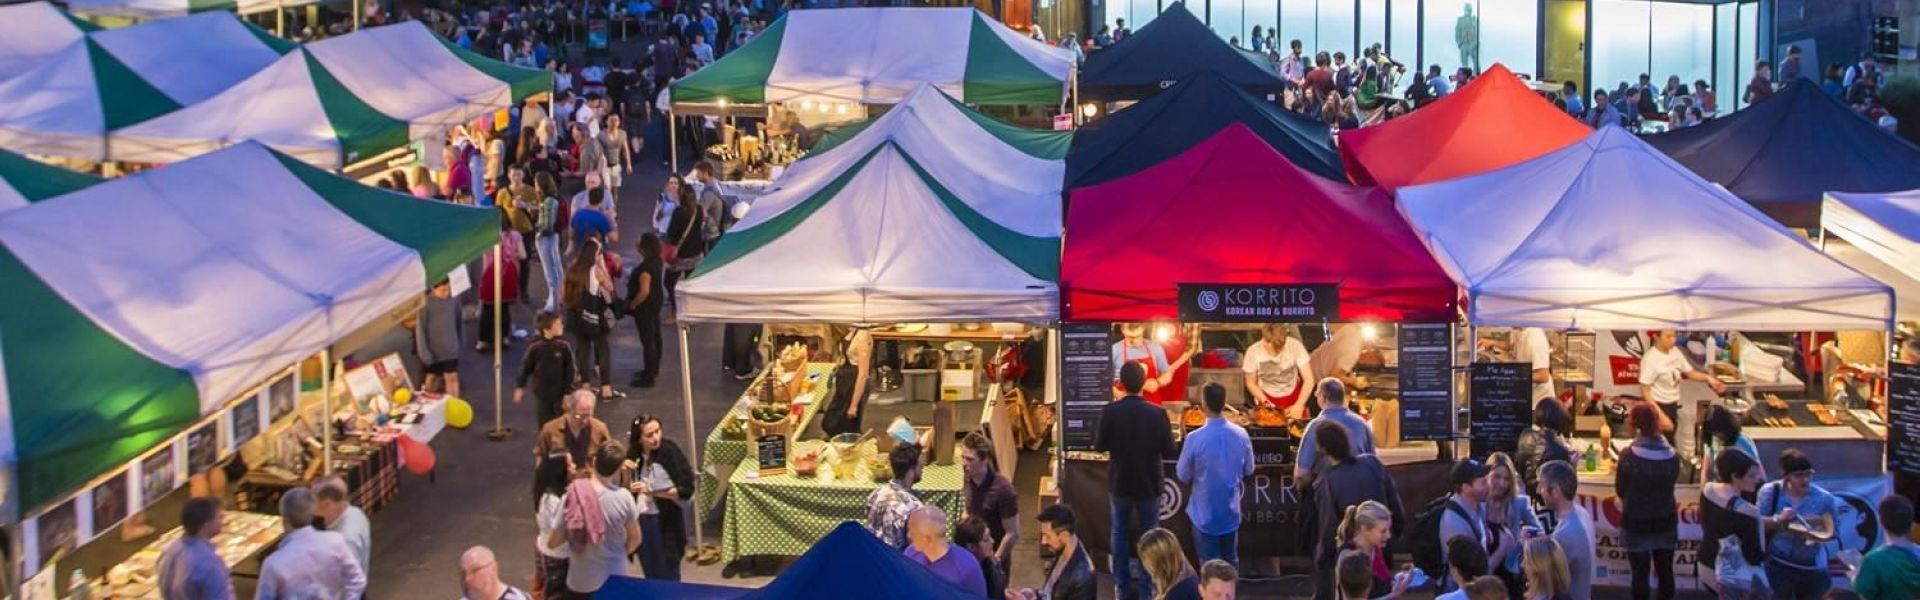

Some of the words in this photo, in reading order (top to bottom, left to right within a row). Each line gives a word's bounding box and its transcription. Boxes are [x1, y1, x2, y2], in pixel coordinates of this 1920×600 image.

[1224, 288, 1315, 305] KORRITO
[1225, 307, 1255, 316] KOREAN
[1256, 307, 1272, 316] BBQ
[1273, 307, 1281, 316] &
[1282, 307, 1315, 316] BURRITO
